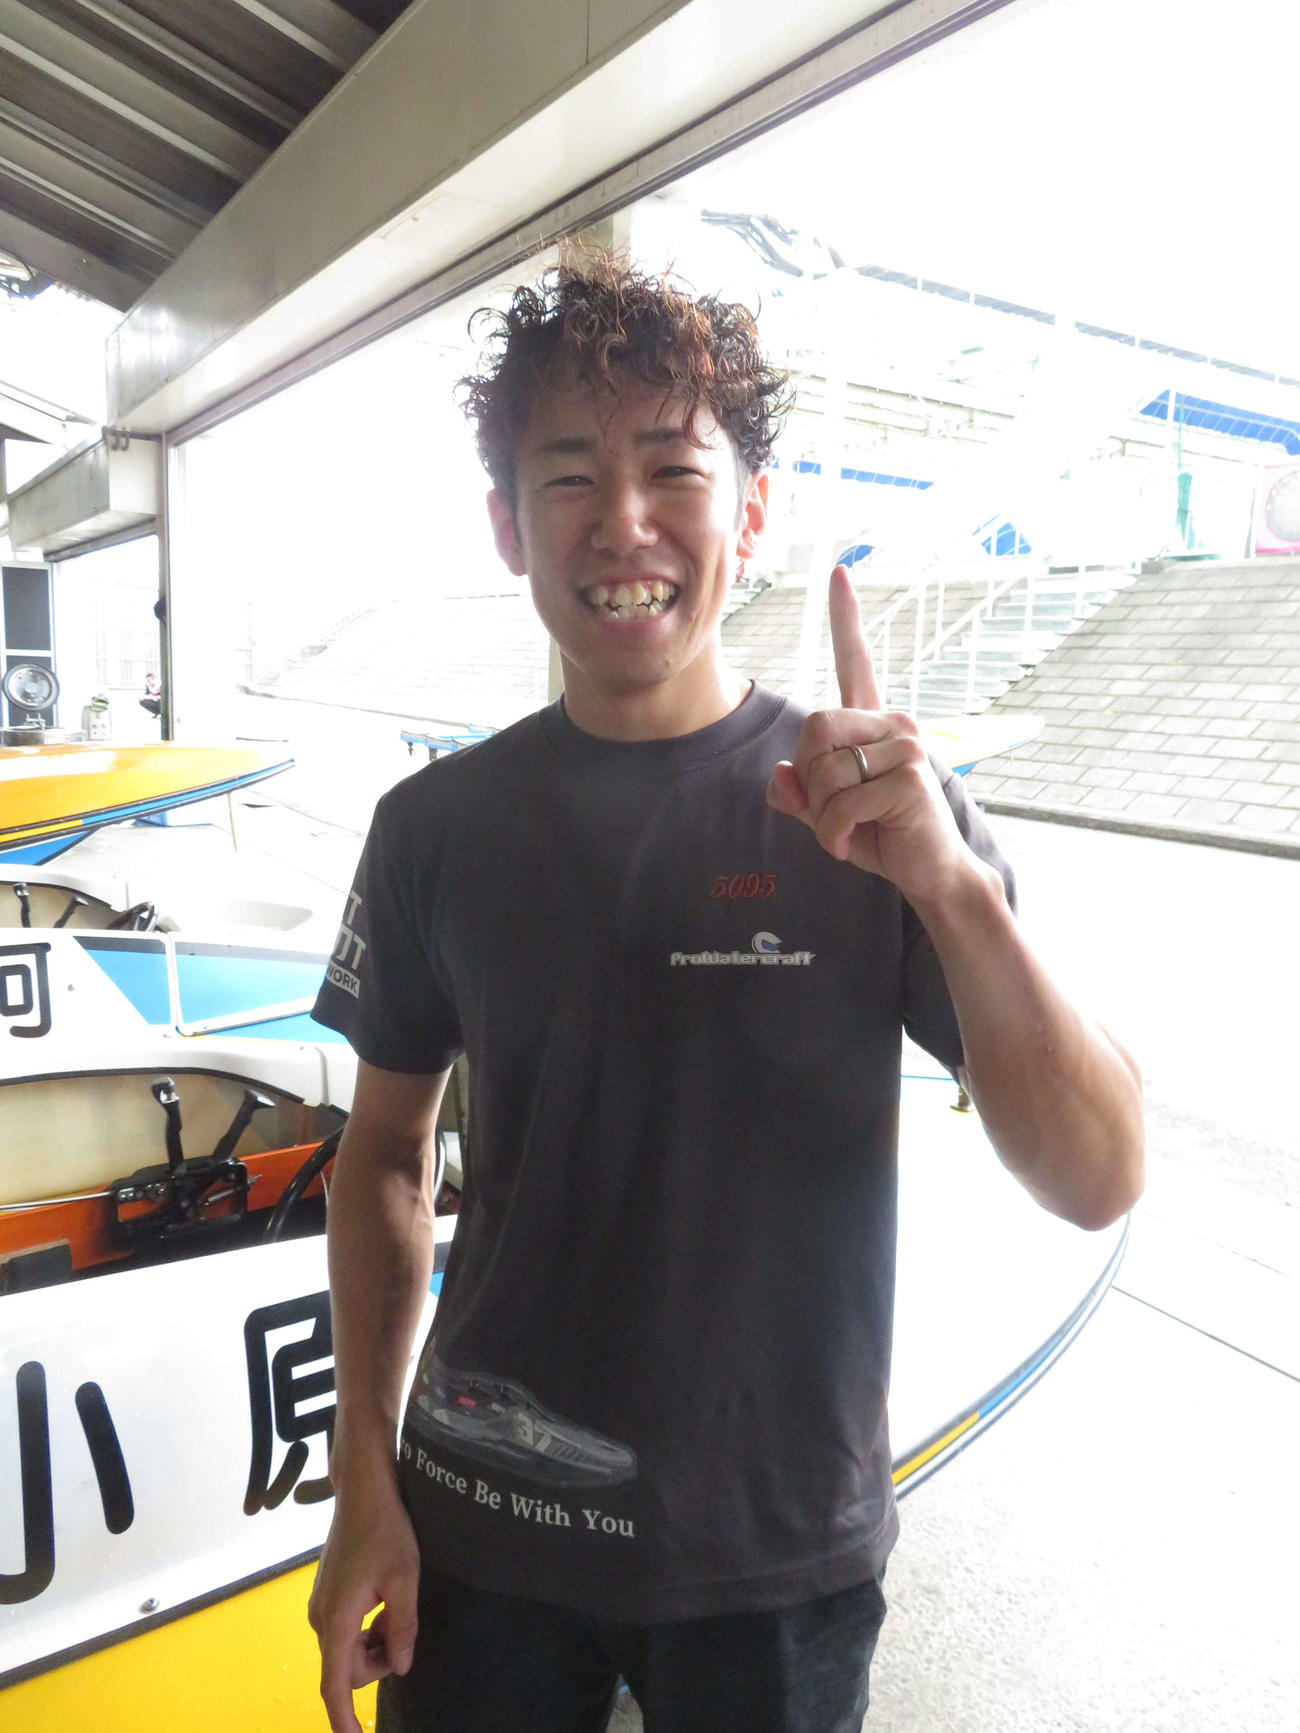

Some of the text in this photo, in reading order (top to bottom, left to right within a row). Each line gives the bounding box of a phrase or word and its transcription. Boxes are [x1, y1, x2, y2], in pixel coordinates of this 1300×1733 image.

[711, 873, 777, 899] 5095
[670, 950, 816, 966] ProWatercraft
[415, 1447, 468, 1494] Force
[473, 1479, 501, 1510] Be
[510, 1493, 572, 1528] With
[582, 1509, 636, 1538] You
